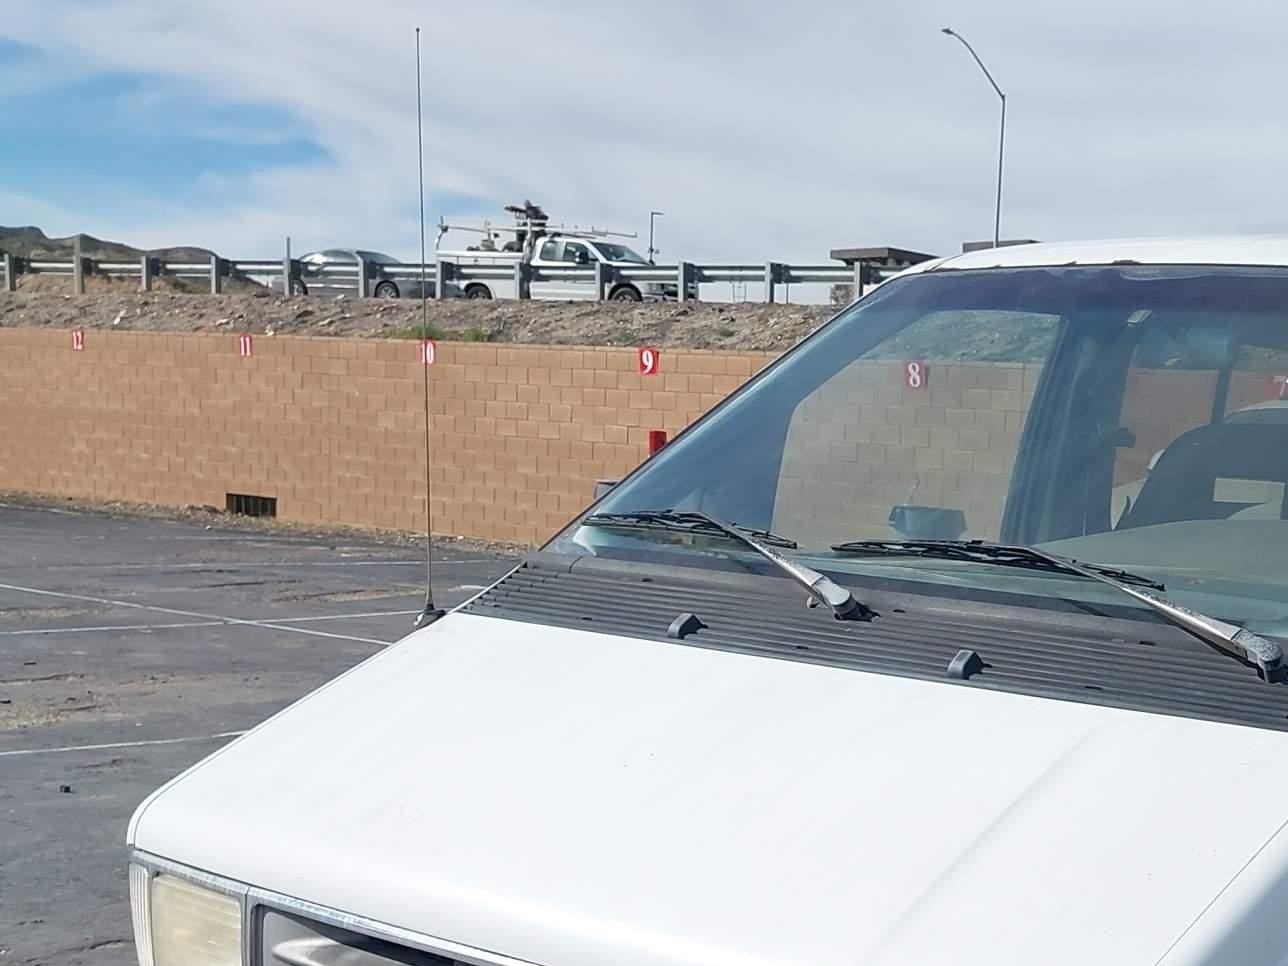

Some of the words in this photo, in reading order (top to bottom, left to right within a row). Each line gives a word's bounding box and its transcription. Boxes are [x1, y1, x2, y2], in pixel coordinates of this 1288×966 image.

[72, 331, 83, 350] 12
[240, 336, 251, 357] 11
[421, 342, 435, 365] 10
[642, 350, 654, 374] 9
[907, 362, 921, 388] 8
